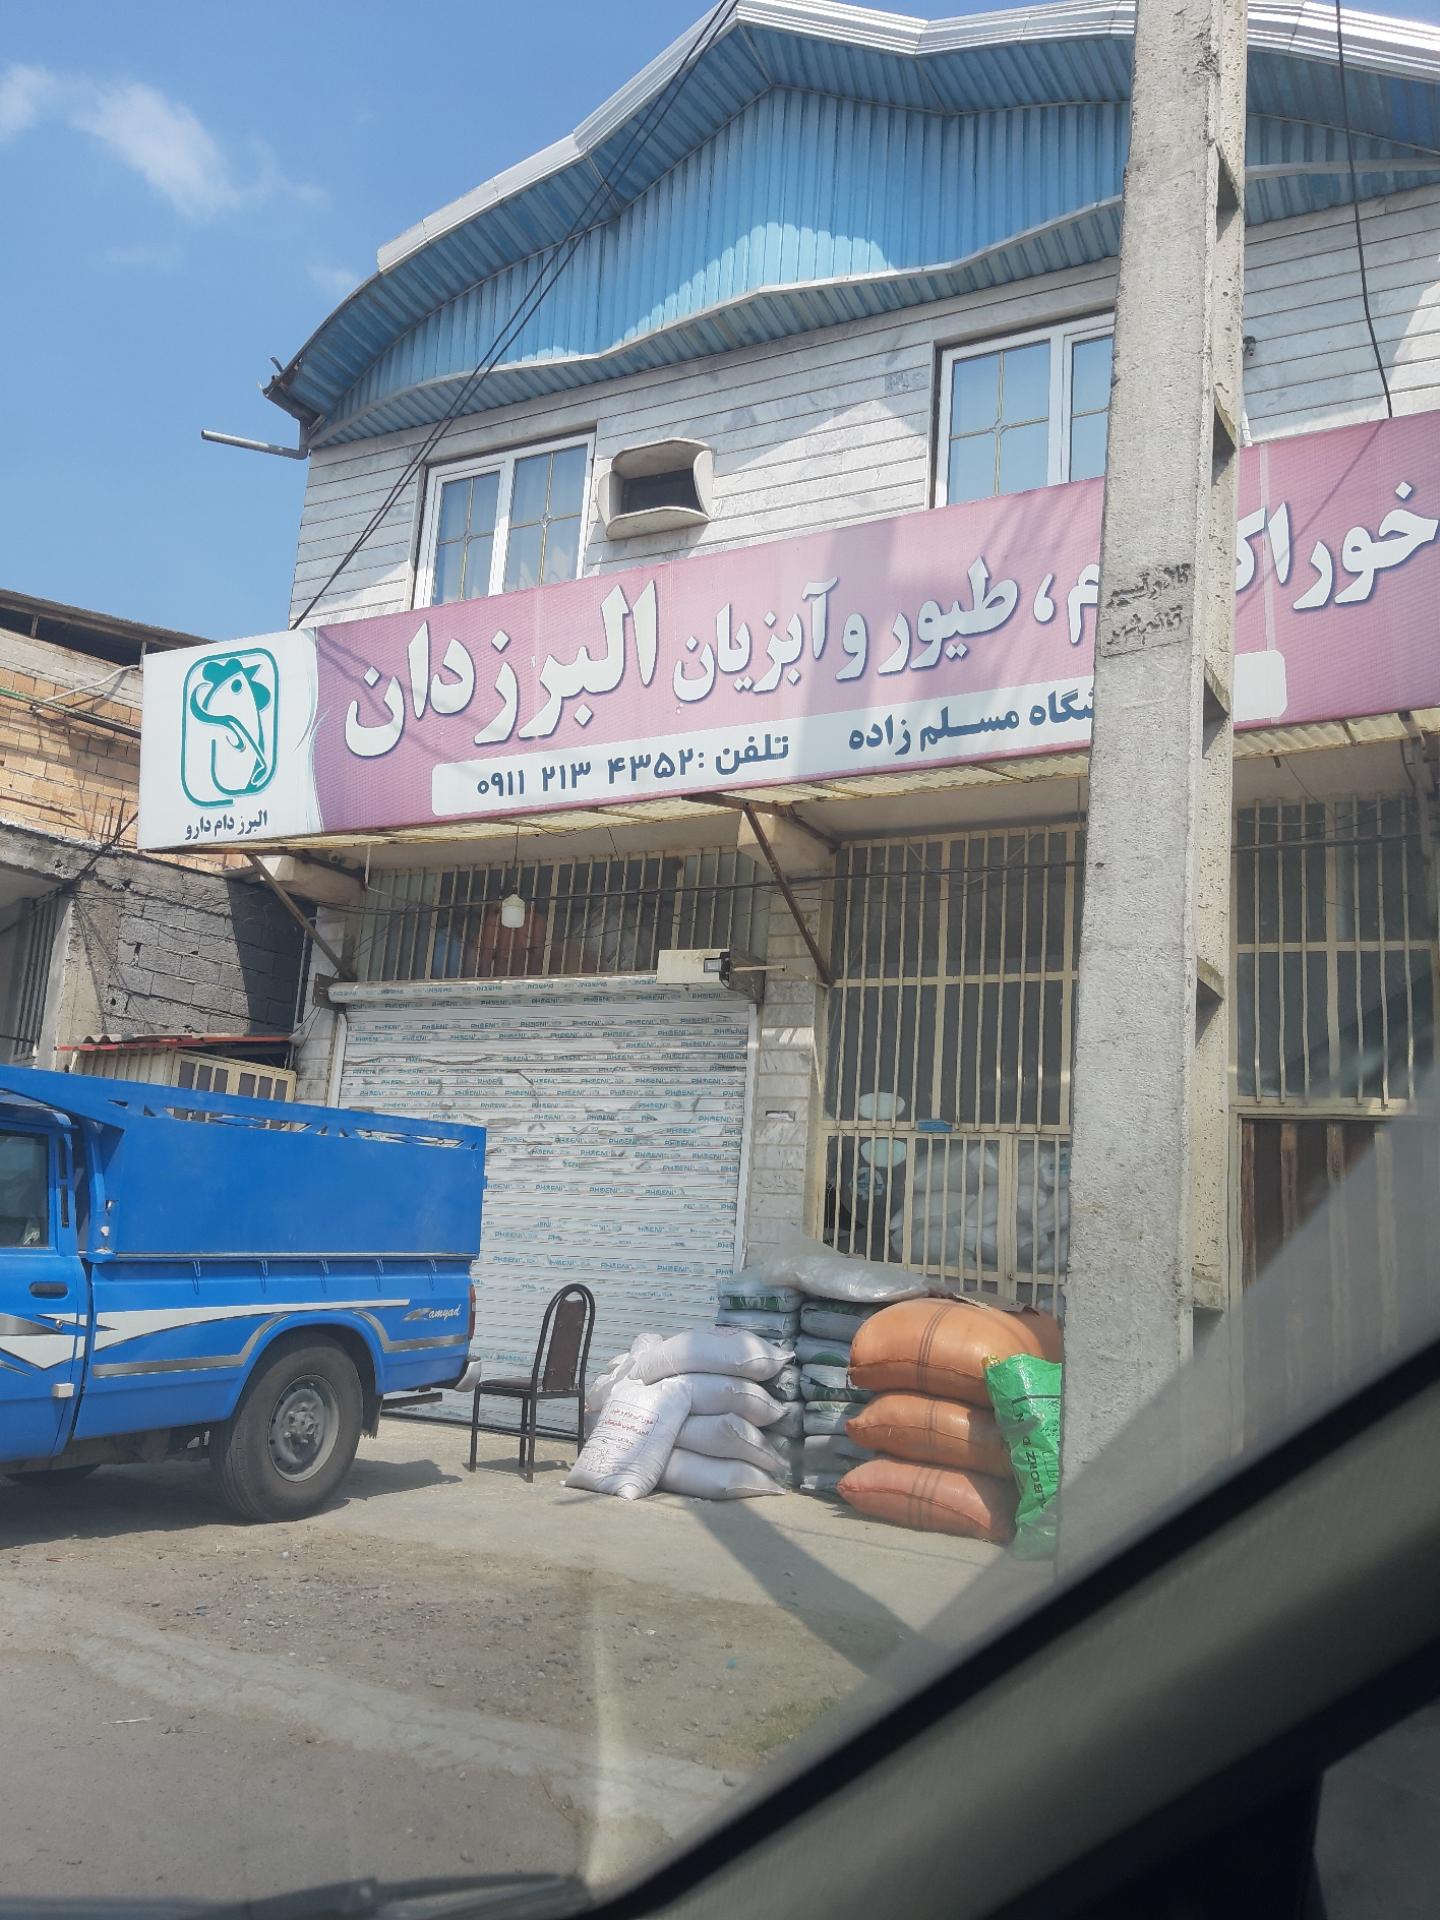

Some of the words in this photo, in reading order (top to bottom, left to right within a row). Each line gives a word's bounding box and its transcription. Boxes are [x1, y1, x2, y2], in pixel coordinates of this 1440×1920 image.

[878, 553, 1019, 674] طیور
[672, 576, 840, 705] آبزیان
[835, 611, 868, 681] و
[849, 713, 912, 755] زاده
[920, 704, 1020, 751] مسلم
[477, 768, 525, 798] ۰۹۱۱
[541, 761, 592, 793] ۲۱۳
[607, 747, 695, 785] ۴۳۵۲
[184, 815, 212, 841] دارو
[214, 813, 235, 837] دام
[237, 808, 268, 836] البرز
